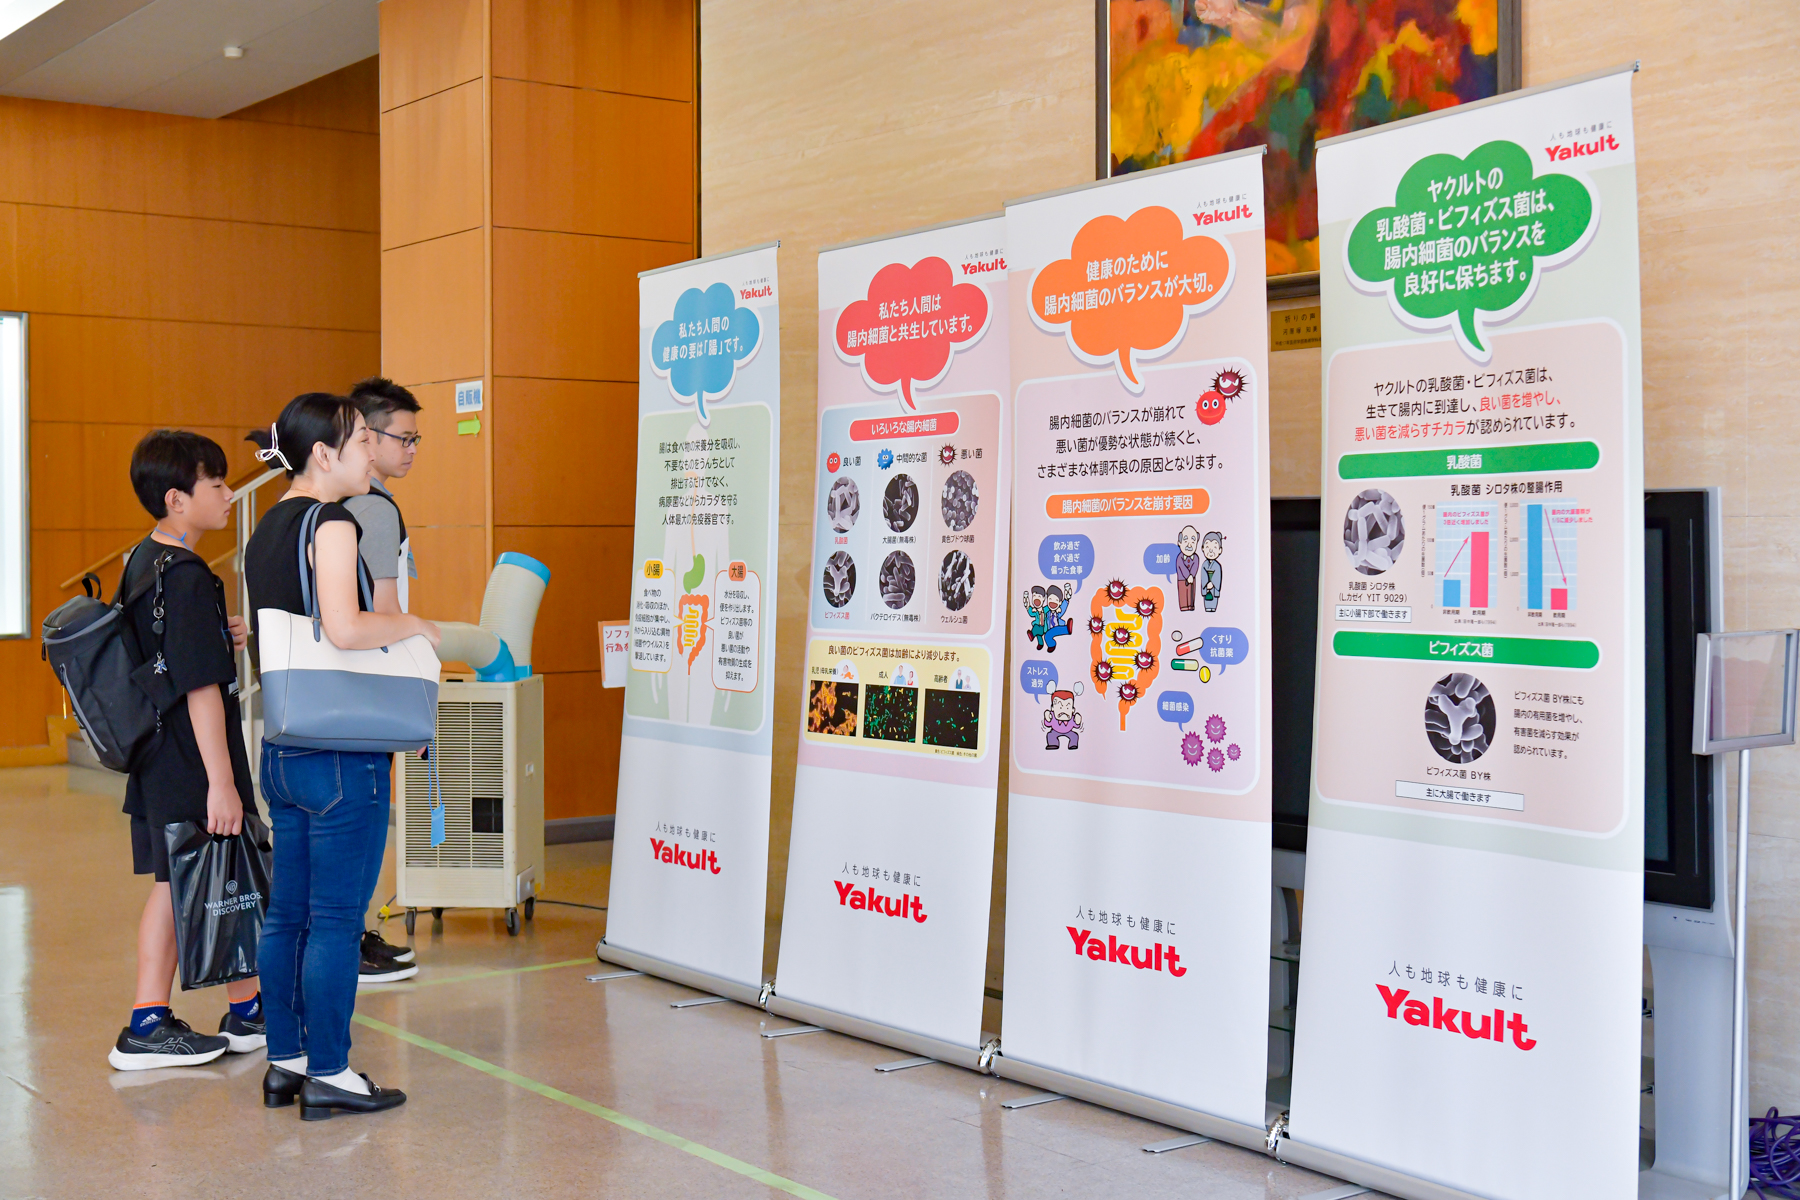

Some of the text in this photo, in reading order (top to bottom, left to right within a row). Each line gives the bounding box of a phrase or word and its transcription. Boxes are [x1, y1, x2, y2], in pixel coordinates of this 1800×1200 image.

[1550, 120, 1612, 141] 人も地球も健康に
[1544, 134, 1620, 162] Yakult
[1427, 167, 1504, 203] ヤクルトの
[1196, 193, 1247, 209] 人も地球も健康に
[1192, 204, 1253, 226] Yakult
[1376, 188, 1554, 243] 乳酸菌・ビフィズス菌は、
[1384, 220, 1546, 271] 腸内細菌のバランスを
[961, 258, 1008, 275] Yakult
[1086, 250, 1169, 282] 健康のために
[1403, 257, 1526, 298] 良好に保ちます。
[740, 285, 772, 300] Yakult
[1044, 272, 1214, 316] 腸内細菌のバランスが大切。
[878, 294, 942, 320] 私たち人間は
[678, 316, 730, 339] 私たち人間の
[846, 314, 973, 348] 腸内細菌と共生しています。
[662, 336, 744, 363] 健康の要は「腸」です。
[1374, 367, 1553, 396] ヤクルトの乳酸菌・ビフィズス菌は、
[458, 388, 480, 406] 自販機
[1366, 391, 1562, 420] 生きて腸内に到達し、良い菌を増やし、
[1049, 405, 1186, 430] 腸内細菌のバランスが崩れて
[871, 418, 937, 436] いろいろな腸内細菌
[1354, 412, 1576, 442] 悪い菌を減らすチカラが認められています。
[659, 438, 740, 454] 腸は食べ物の栄養分を吸収し、
[1055, 430, 1200, 454] 悪い菌が優勢な状態が続くと、
[842, 456, 862, 467] 良い菌
[896, 452, 928, 464] 中間的な菌
[960, 448, 982, 460] 悪い菌
[1446, 454, 1482, 470] 乳酸菌
[664, 457, 735, 472] 不要なものをうんちとして
[1037, 454, 1224, 478] さまざまな体調不良の原因となります。
[671, 476, 728, 490] 排出するだけでなく、
[1450, 480, 1563, 496] 乳酸菌 シロタ株の整腸作用
[658, 494, 738, 508] 病原菌などからカラダを守る
[1062, 494, 1193, 514] 腸内細菌のバランスを崩す要因
[662, 513, 734, 526] 人体最大の免疫器官です。
[1054, 541, 1080, 550] 飲み過ぎ
[1054, 553, 1080, 563] 食べ過ぎ
[1156, 554, 1170, 564] 加齢
[646, 564, 660, 576] 小腸
[731, 565, 744, 578] 大腸
[1050, 565, 1083, 575] 偏った食事
[1348, 582, 1396, 591] 乳酸菌 シロタ株
[1366, 594, 1381, 602] YIT
[1338, 608, 1408, 620] 主に小腸下部で働きます
[1211, 634, 1232, 644] くすり
[828, 645, 960, 662] 良い菌のビフィズス菌は加齢により減少します。
[1210, 648, 1234, 658] 抗菌薬
[1429, 640, 1494, 658] ビフィズス菌
[878, 671, 888, 679] 成人
[934, 674, 948, 684] 高齢者
[1027, 666, 1048, 676] ストレス
[1031, 678, 1044, 688] 過労
[1162, 700, 1190, 712] 細菌感染
[1514, 691, 1584, 705] ビフィズス菌 BY株にも
[1514, 709, 1582, 724] 腸内の有用菌を増やし、
[1514, 727, 1580, 741] 有害菌を減らす効果が
[1514, 744, 1568, 760] 認められています。
[1426, 766, 1491, 780] ビフィズス菌 BY株
[1426, 788, 1492, 804] 主に大腸で働きます
[655, 822, 716, 842] 人も地球も健康に
[650, 837, 722, 874] Yakult
[842, 862, 921, 887] 人も地球も健康に
[204, 892, 263, 910] WARNER BROS.
[212, 900, 256, 917] DISCOVERY
[834, 880, 928, 924] Yakult
[1076, 905, 1176, 935] 人も地球も健康に
[1066, 926, 1188, 978] Yakult
[1388, 960, 1523, 1000] 人も地球も健康に
[1375, 983, 1537, 1051] Yakult
